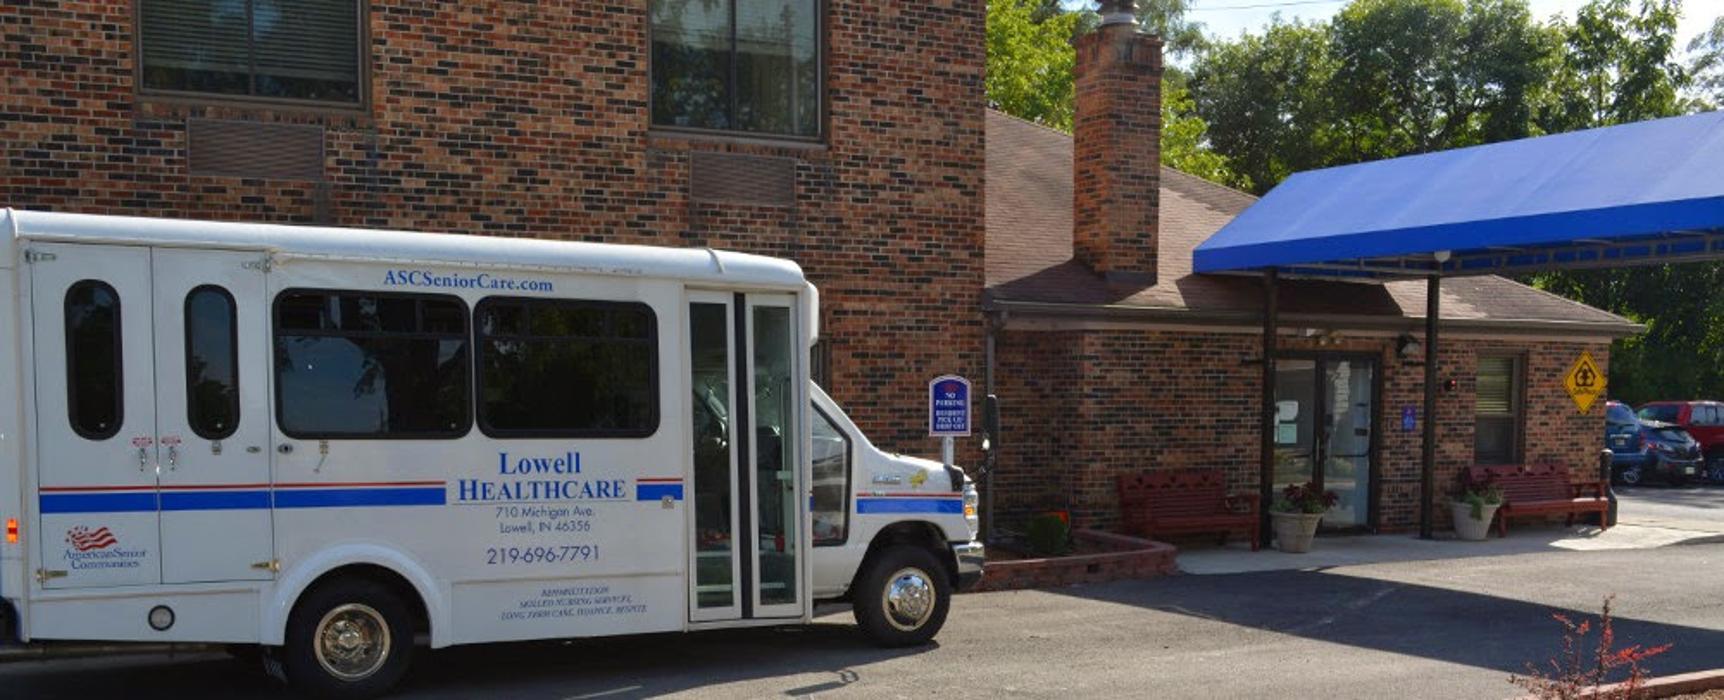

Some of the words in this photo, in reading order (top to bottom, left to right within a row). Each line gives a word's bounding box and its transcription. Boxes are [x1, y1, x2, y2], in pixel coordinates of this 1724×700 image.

[384, 269, 554, 292] ASCSeniorCare.com
[498, 451, 582, 475] Lowell
[458, 479, 627, 501] HEALTHCARE
[496, 506, 519, 519] 710
[521, 504, 571, 520] Michigan
[573, 505, 596, 517] Ave.
[500, 521, 536, 535] Lowell,
[538, 521, 553, 532] IN
[555, 519, 591, 532] 46356
[487, 543, 600, 565] 219-696-7791
